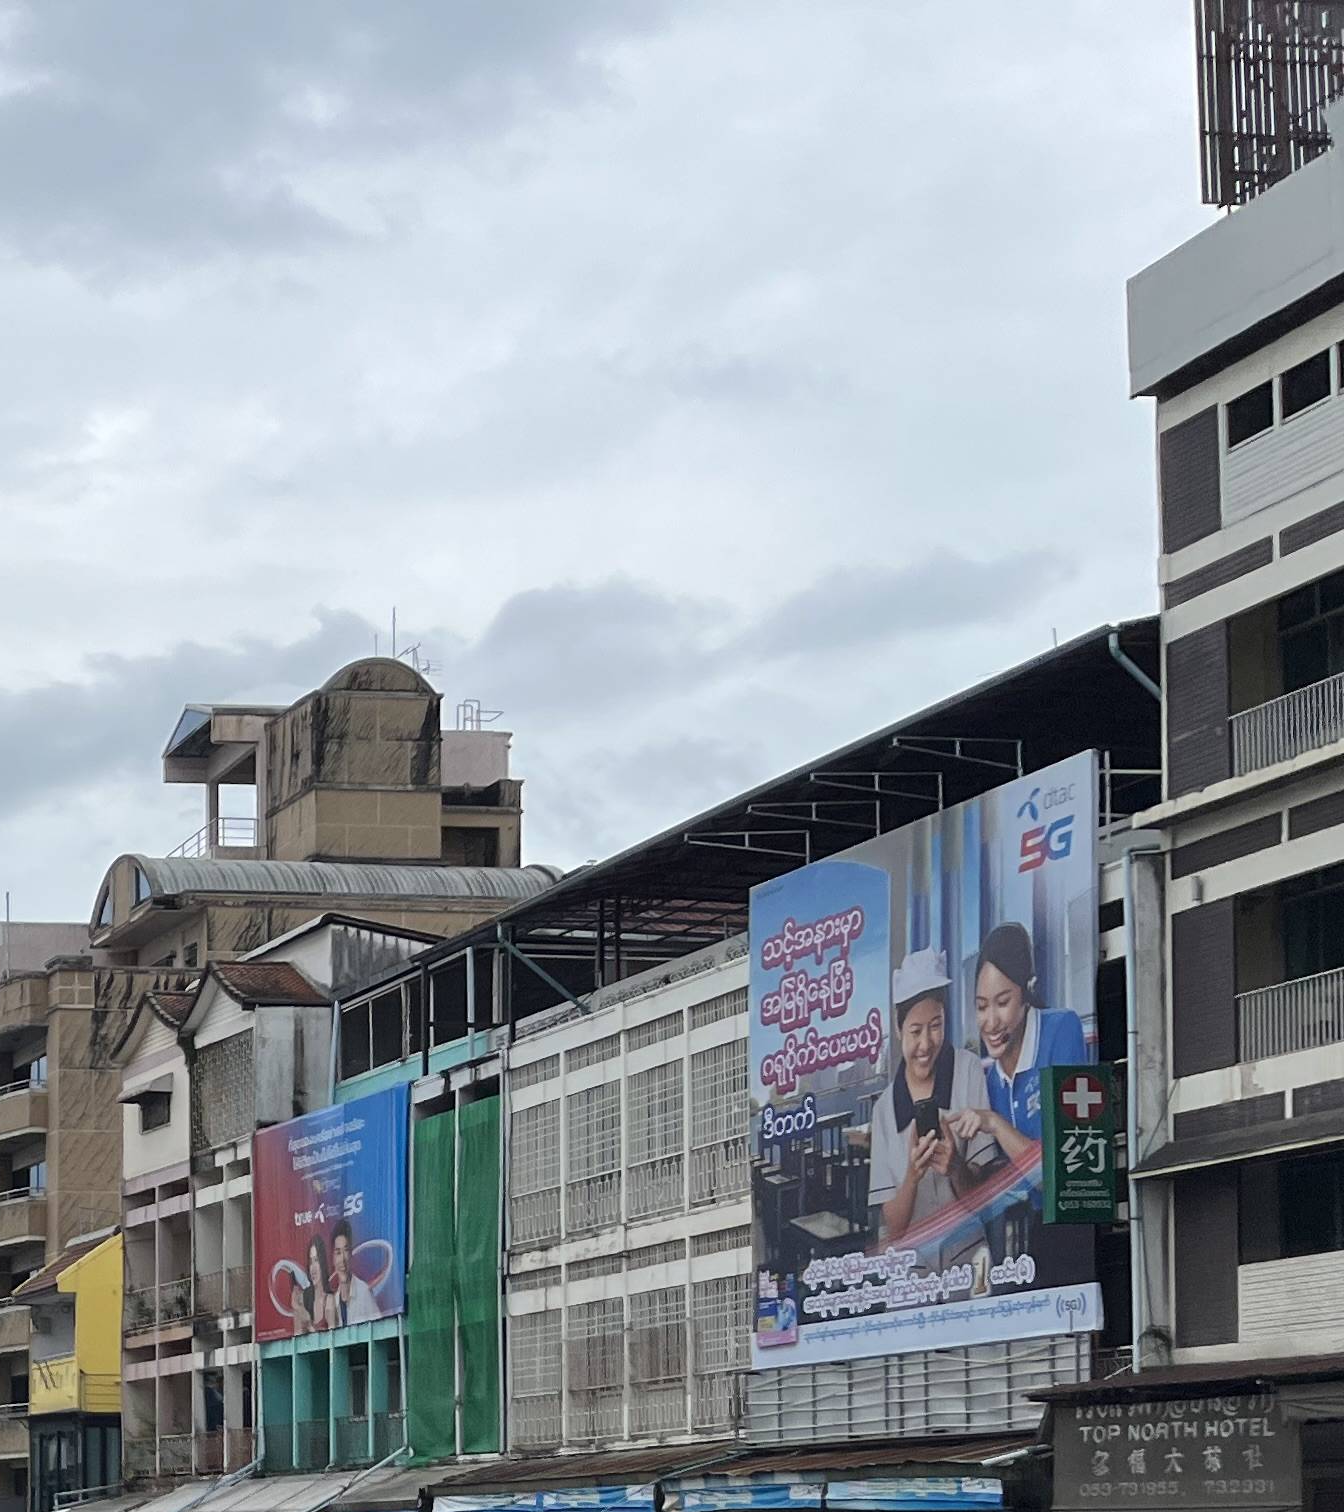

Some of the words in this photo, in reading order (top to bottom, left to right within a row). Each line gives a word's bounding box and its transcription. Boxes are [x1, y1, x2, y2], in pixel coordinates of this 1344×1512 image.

[1044, 783, 1075, 809] dtac
[1018, 815, 1075, 873] 5G
[1060, 1125, 1108, 1174] 药
[343, 1191, 364, 1217] 5G
[973, 1252, 989, 1296] 1
[1079, 1425, 1121, 1443] TOP
[1127, 1421, 1198, 1442] NORTH
[1204, 1417, 1275, 1438] HOTEL
